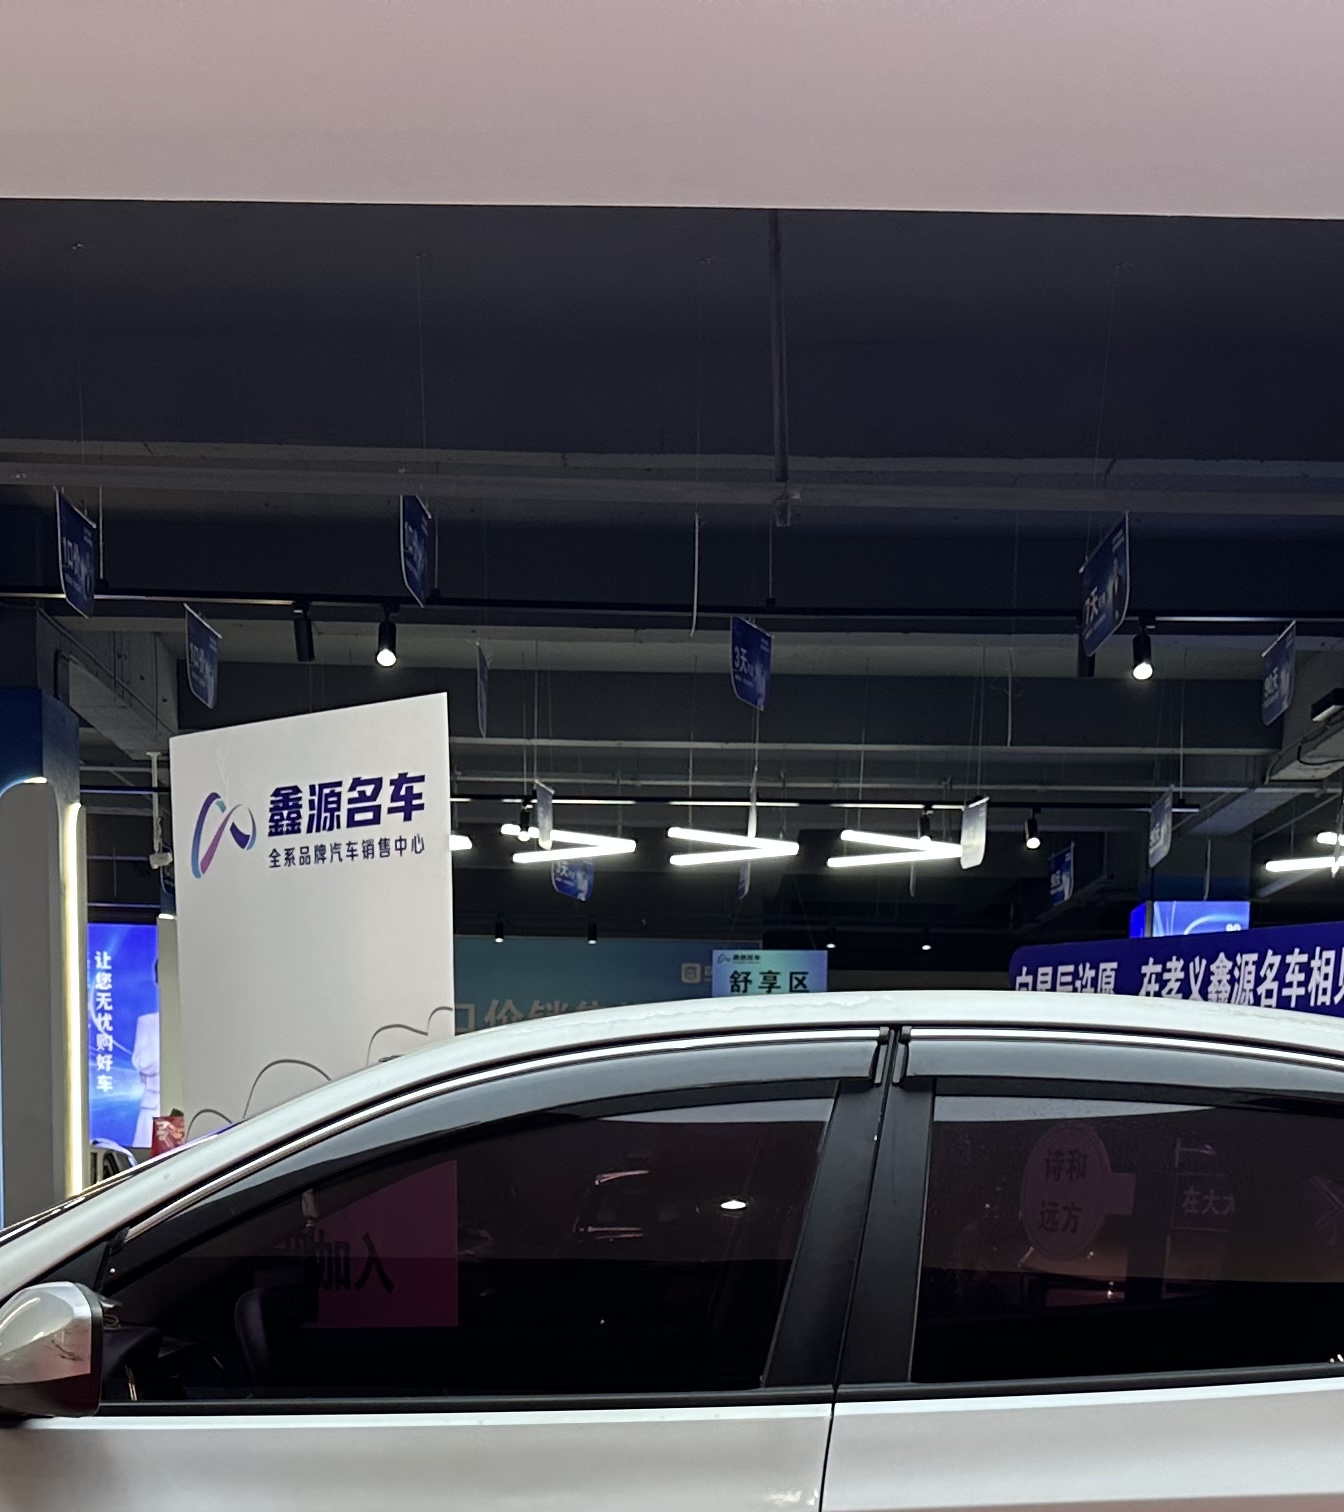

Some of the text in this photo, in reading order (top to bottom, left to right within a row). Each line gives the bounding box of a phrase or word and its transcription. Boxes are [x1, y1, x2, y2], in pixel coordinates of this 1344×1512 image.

[268, 772, 425, 837] 鑫源名车
[268, 832, 425, 869] 全系品牌汽车销售中心
[729, 970, 810, 993] 舒享区
[94, 951, 113, 1093] 让您无忧购好车
[1038, 1201, 1083, 1235] 远方
